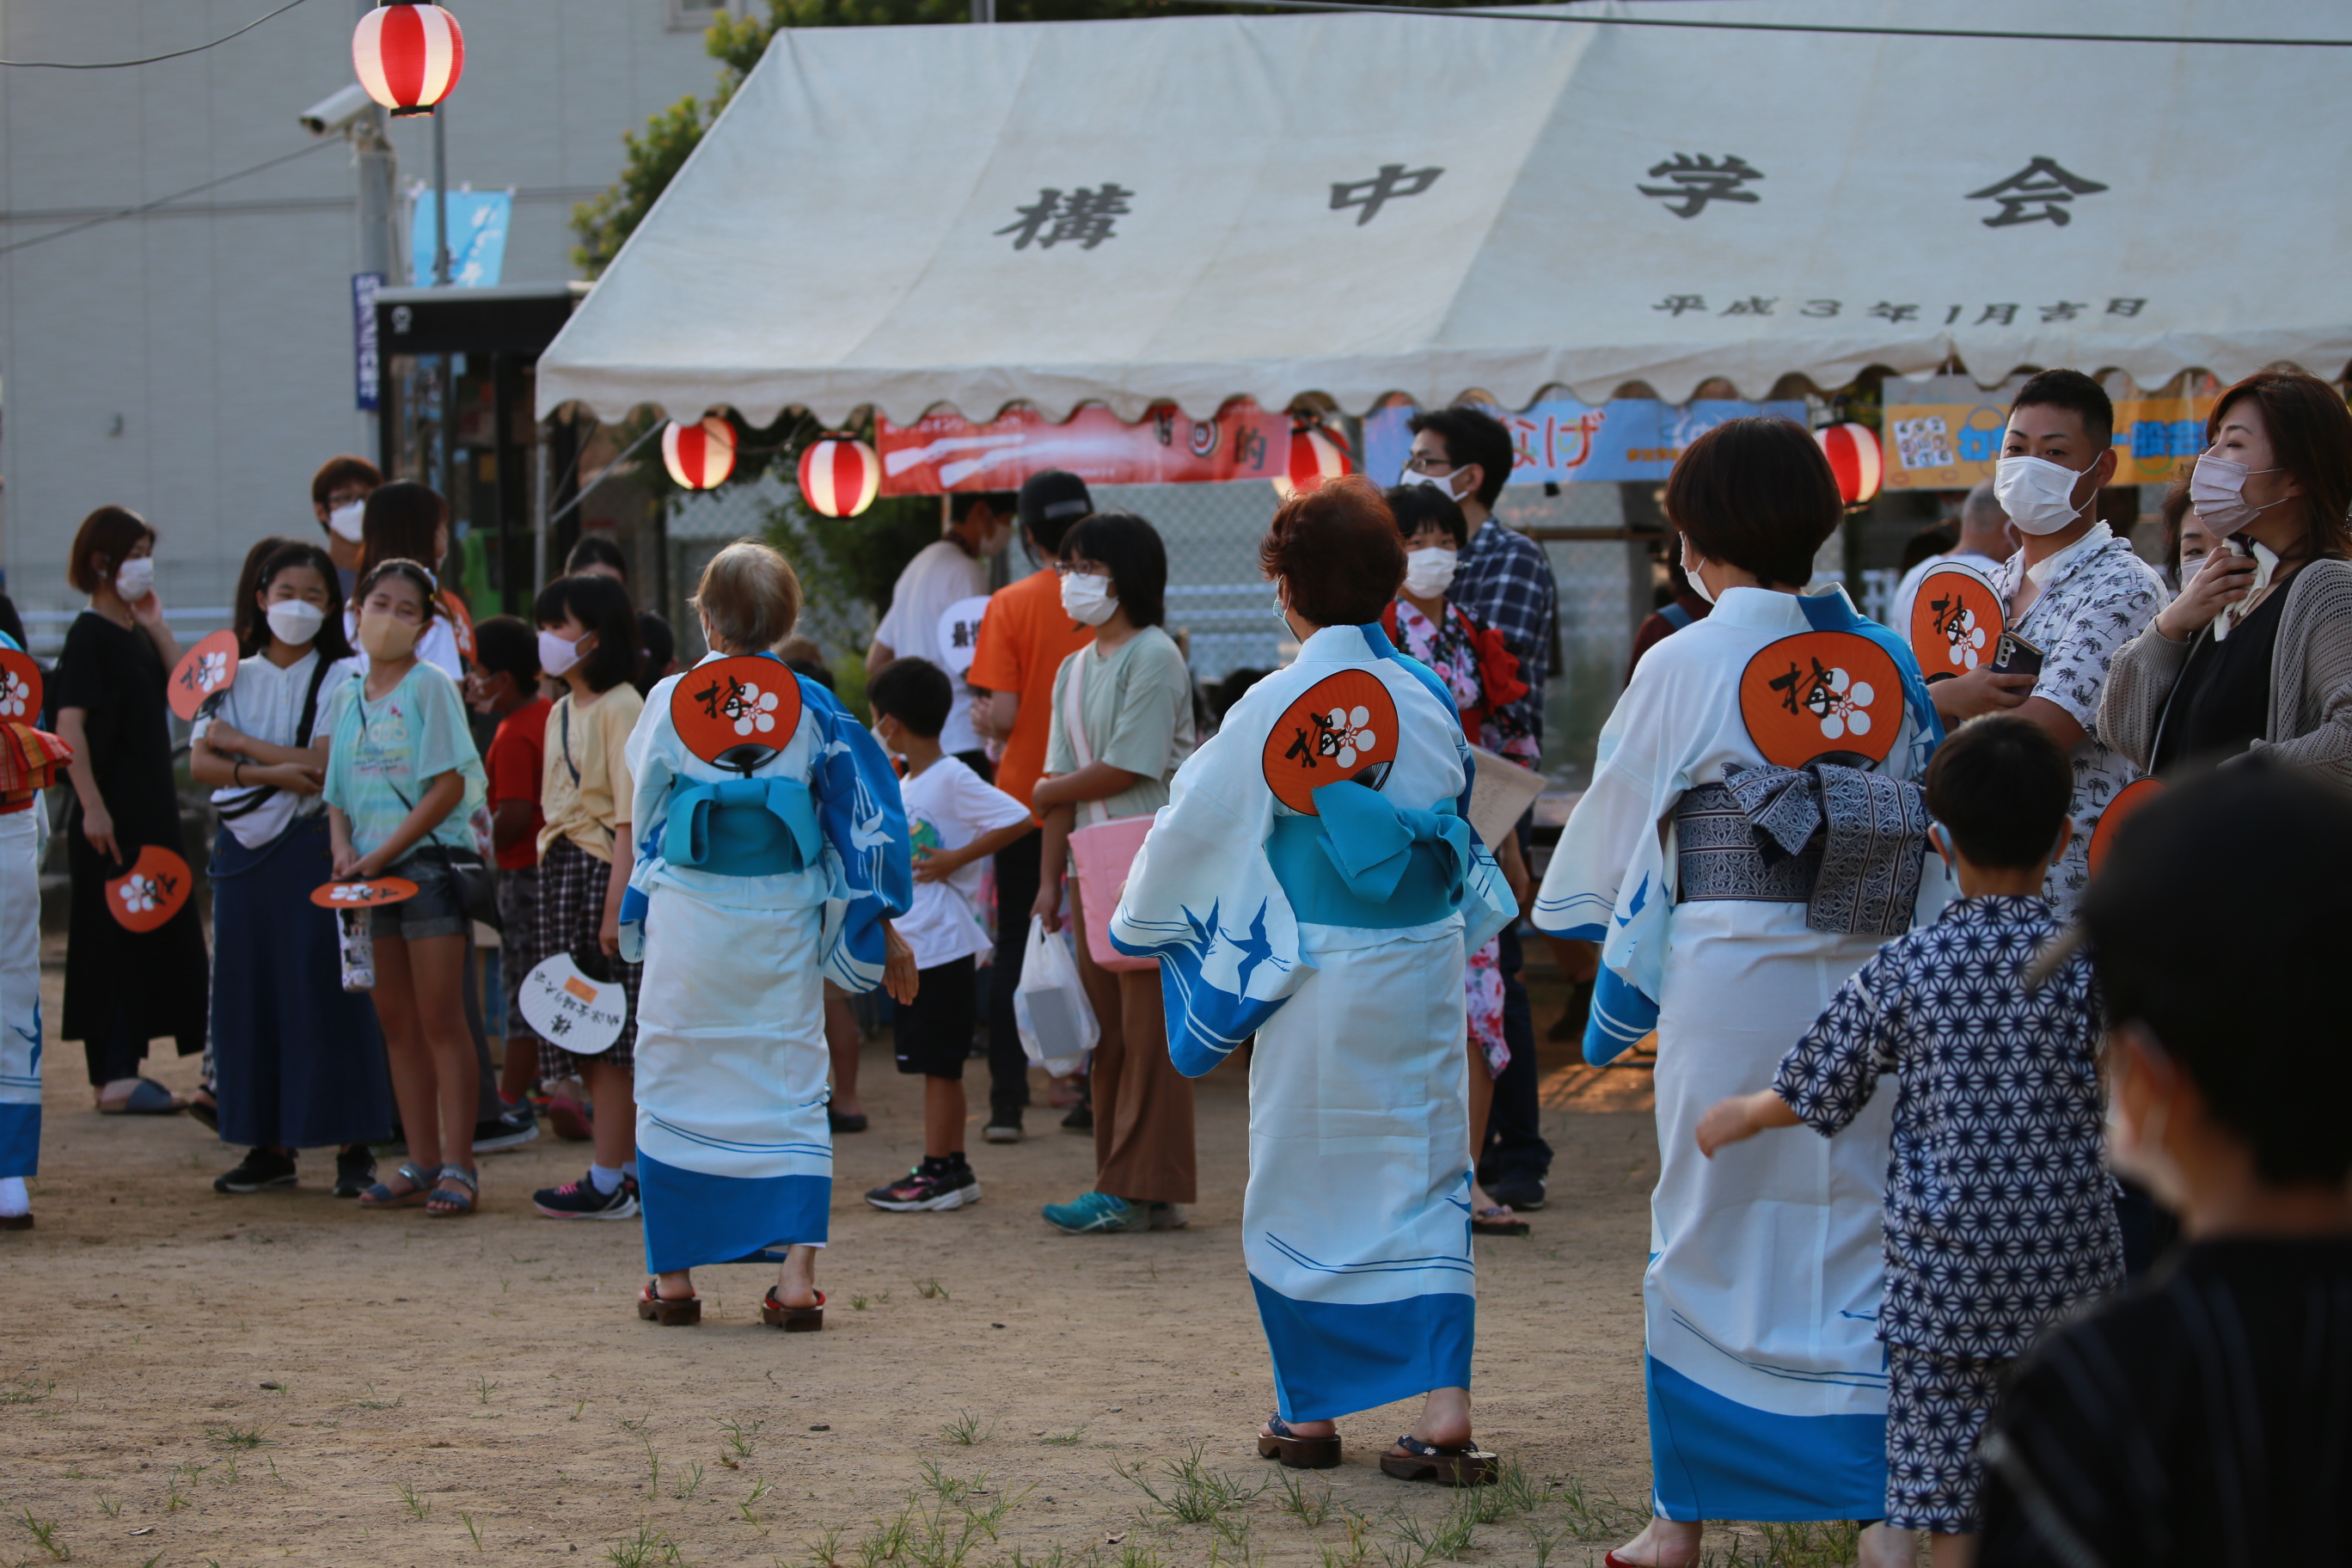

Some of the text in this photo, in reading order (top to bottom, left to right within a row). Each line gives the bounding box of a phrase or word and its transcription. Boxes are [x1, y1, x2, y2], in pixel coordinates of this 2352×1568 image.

[997, 153, 2109, 249] 構中学会
[1653, 294, 2147, 326] 平成3年1月吉日
[1931, 591, 1968, 646] 梅
[694, 675, 753, 722] 梅
[1768, 656, 1842, 720] 梅
[1285, 711, 1346, 769] 梅
